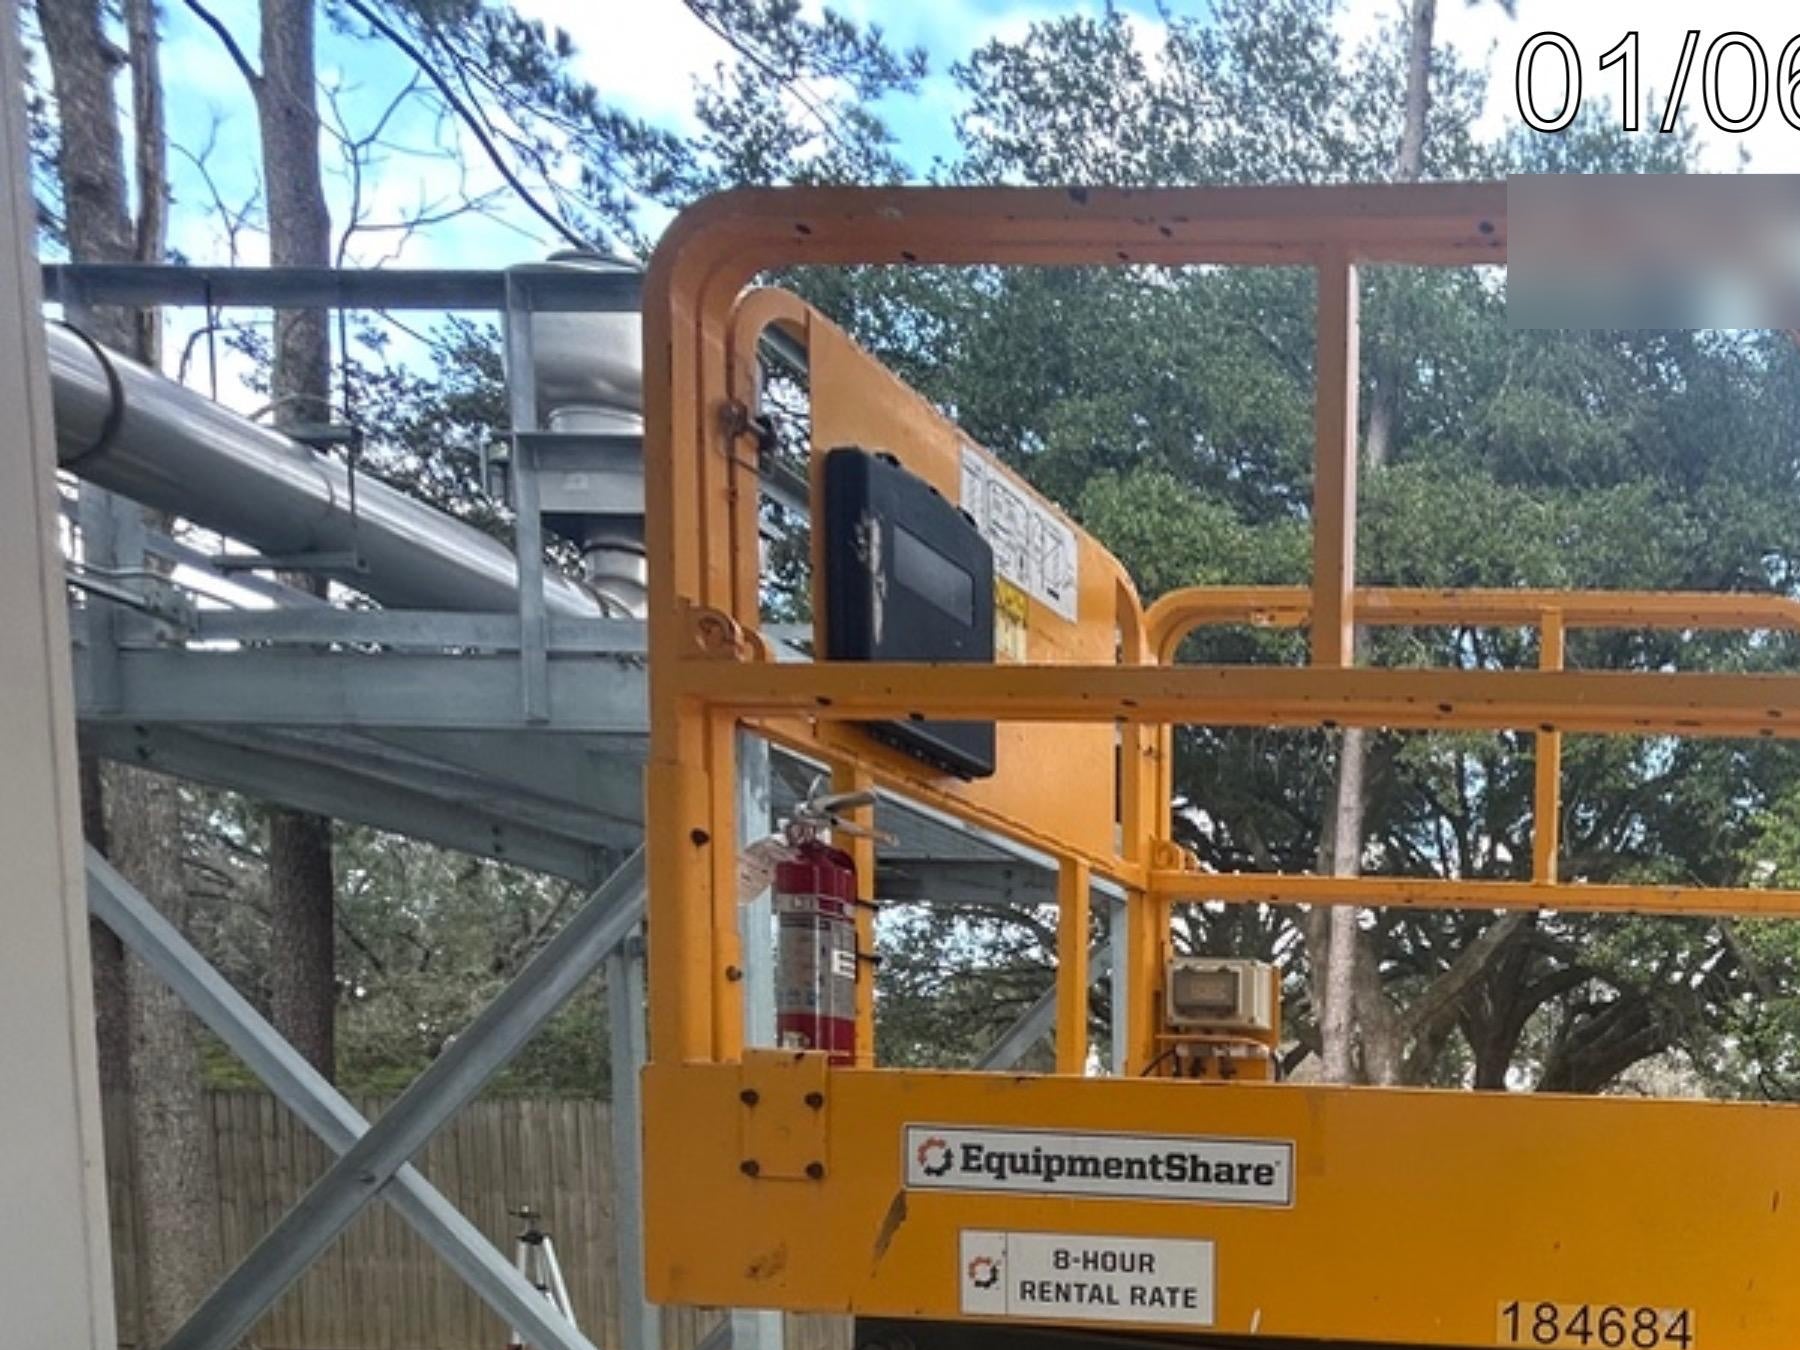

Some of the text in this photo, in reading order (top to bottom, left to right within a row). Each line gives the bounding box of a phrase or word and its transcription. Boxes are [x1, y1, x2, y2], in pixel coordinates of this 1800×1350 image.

[959, 1142, 1276, 1187] EquipmentShare
[1053, 1248, 1156, 1274] 8-HOUR
[1019, 1280, 1198, 1310] RENTAL RATE
[1502, 1300, 1693, 1350] 184684
